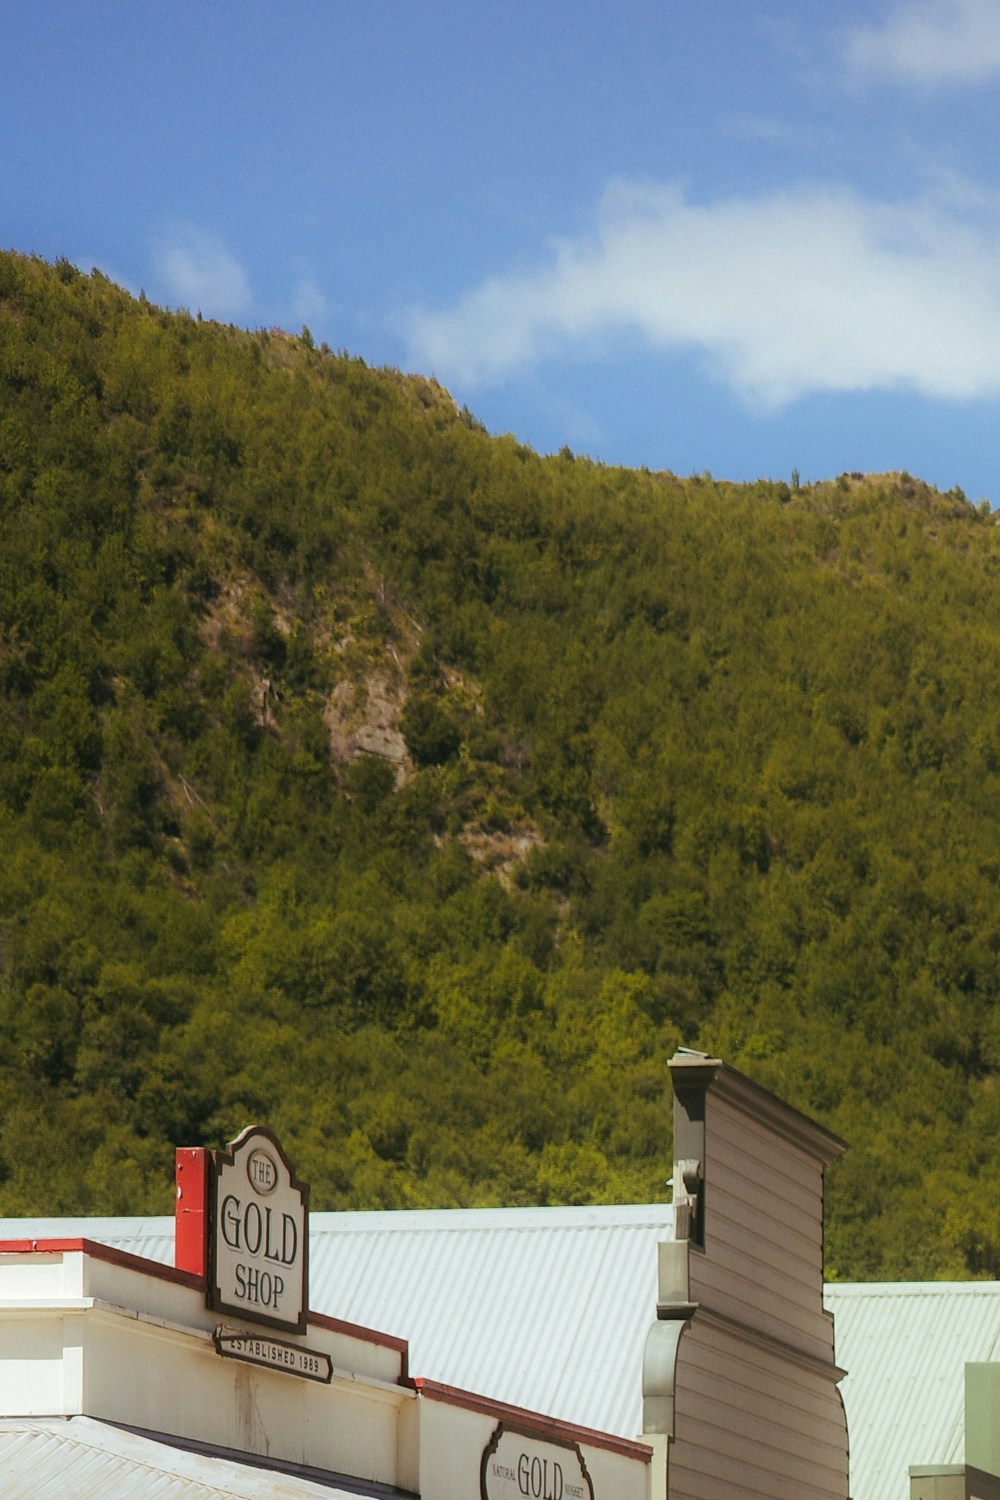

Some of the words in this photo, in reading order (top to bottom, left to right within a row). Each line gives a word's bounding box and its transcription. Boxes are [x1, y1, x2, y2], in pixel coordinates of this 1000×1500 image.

[252, 1159, 272, 1185] THE
[220, 1194, 298, 1266] GOLD
[234, 1263, 285, 1309] SHOP
[230, 1339, 296, 1366] ESTABLISHED
[299, 1355, 320, 1373] 1989
[492, 1463, 516, 1481] NATURAL
